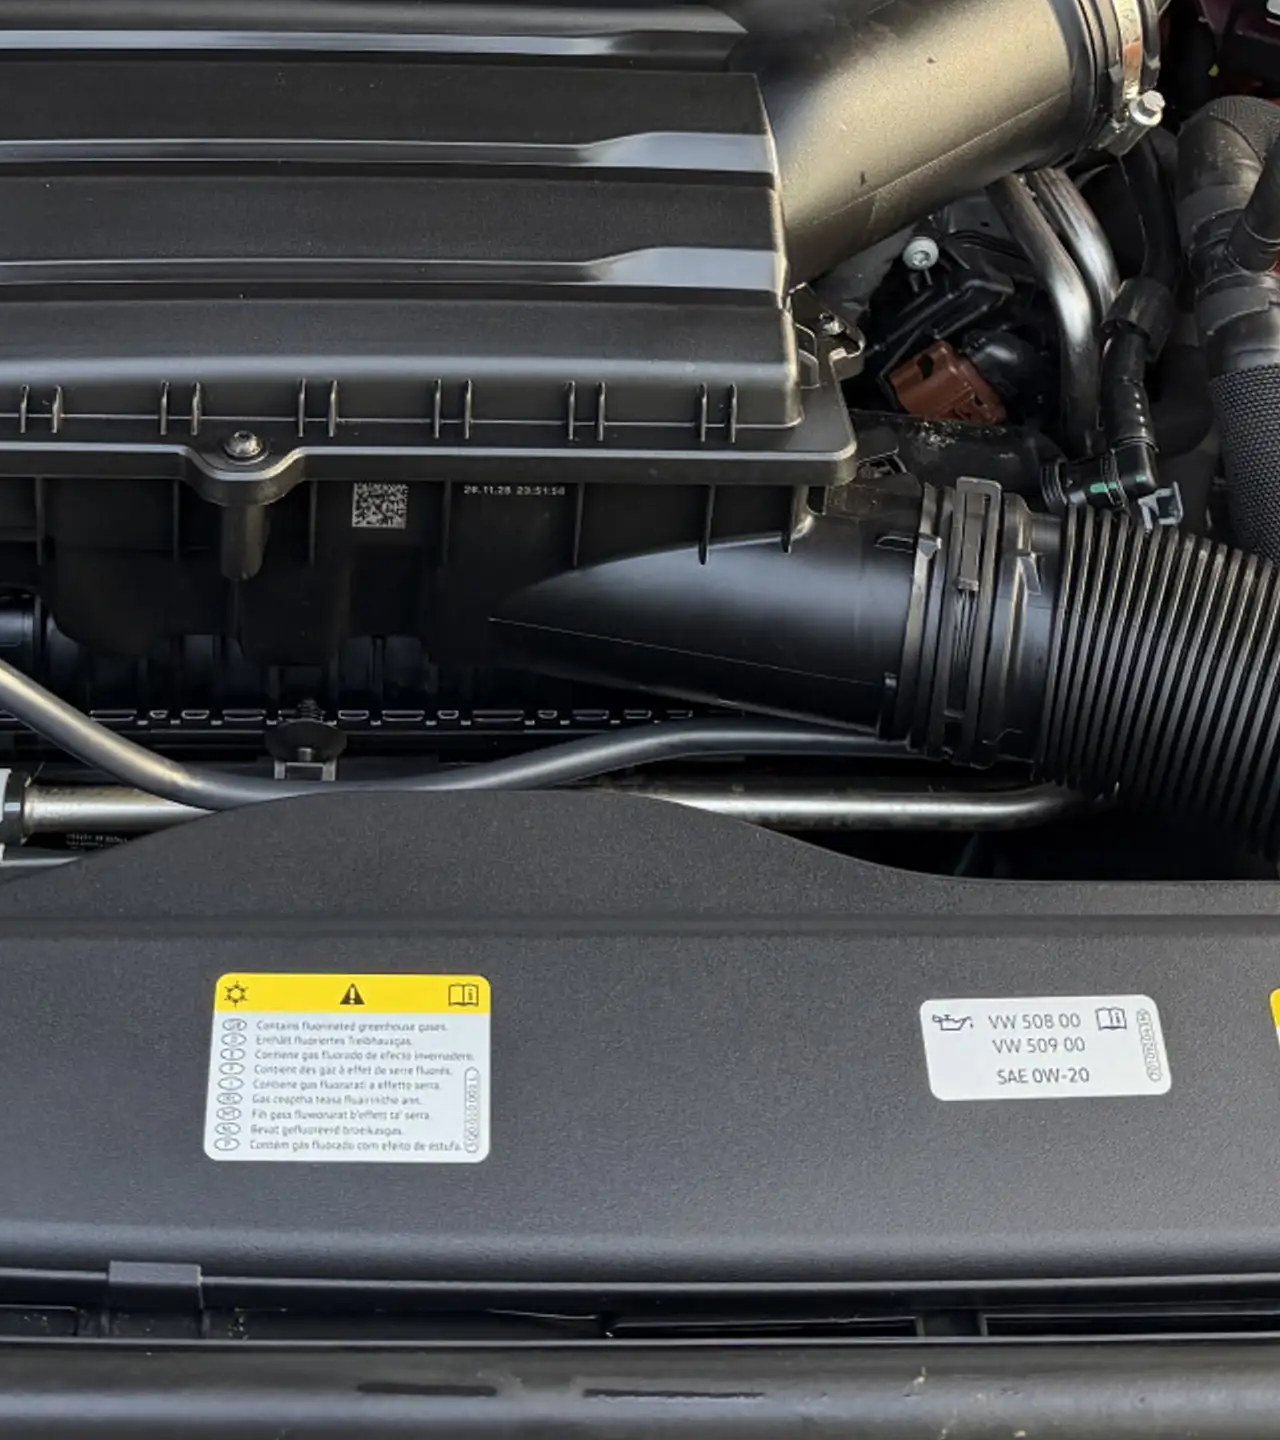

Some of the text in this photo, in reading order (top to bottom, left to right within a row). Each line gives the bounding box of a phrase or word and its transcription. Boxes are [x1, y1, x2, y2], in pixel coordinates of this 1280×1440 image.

[256, 1020, 300, 1031] Contains
[301, 1020, 356, 1031] fluorinated
[358, 1021, 416, 1034] greenhouse
[988, 1012, 1082, 1030] VW 508 00
[992, 1036, 1086, 1055] VW 509 00
[254, 1050, 300, 1061] Contiene
[301, 1052, 319, 1063] gas
[365, 1051, 377, 1061] de
[380, 1051, 412, 1062] efecto
[253, 1064, 298, 1075] Contient
[996, 1067, 1090, 1085] SAE 0W-20
